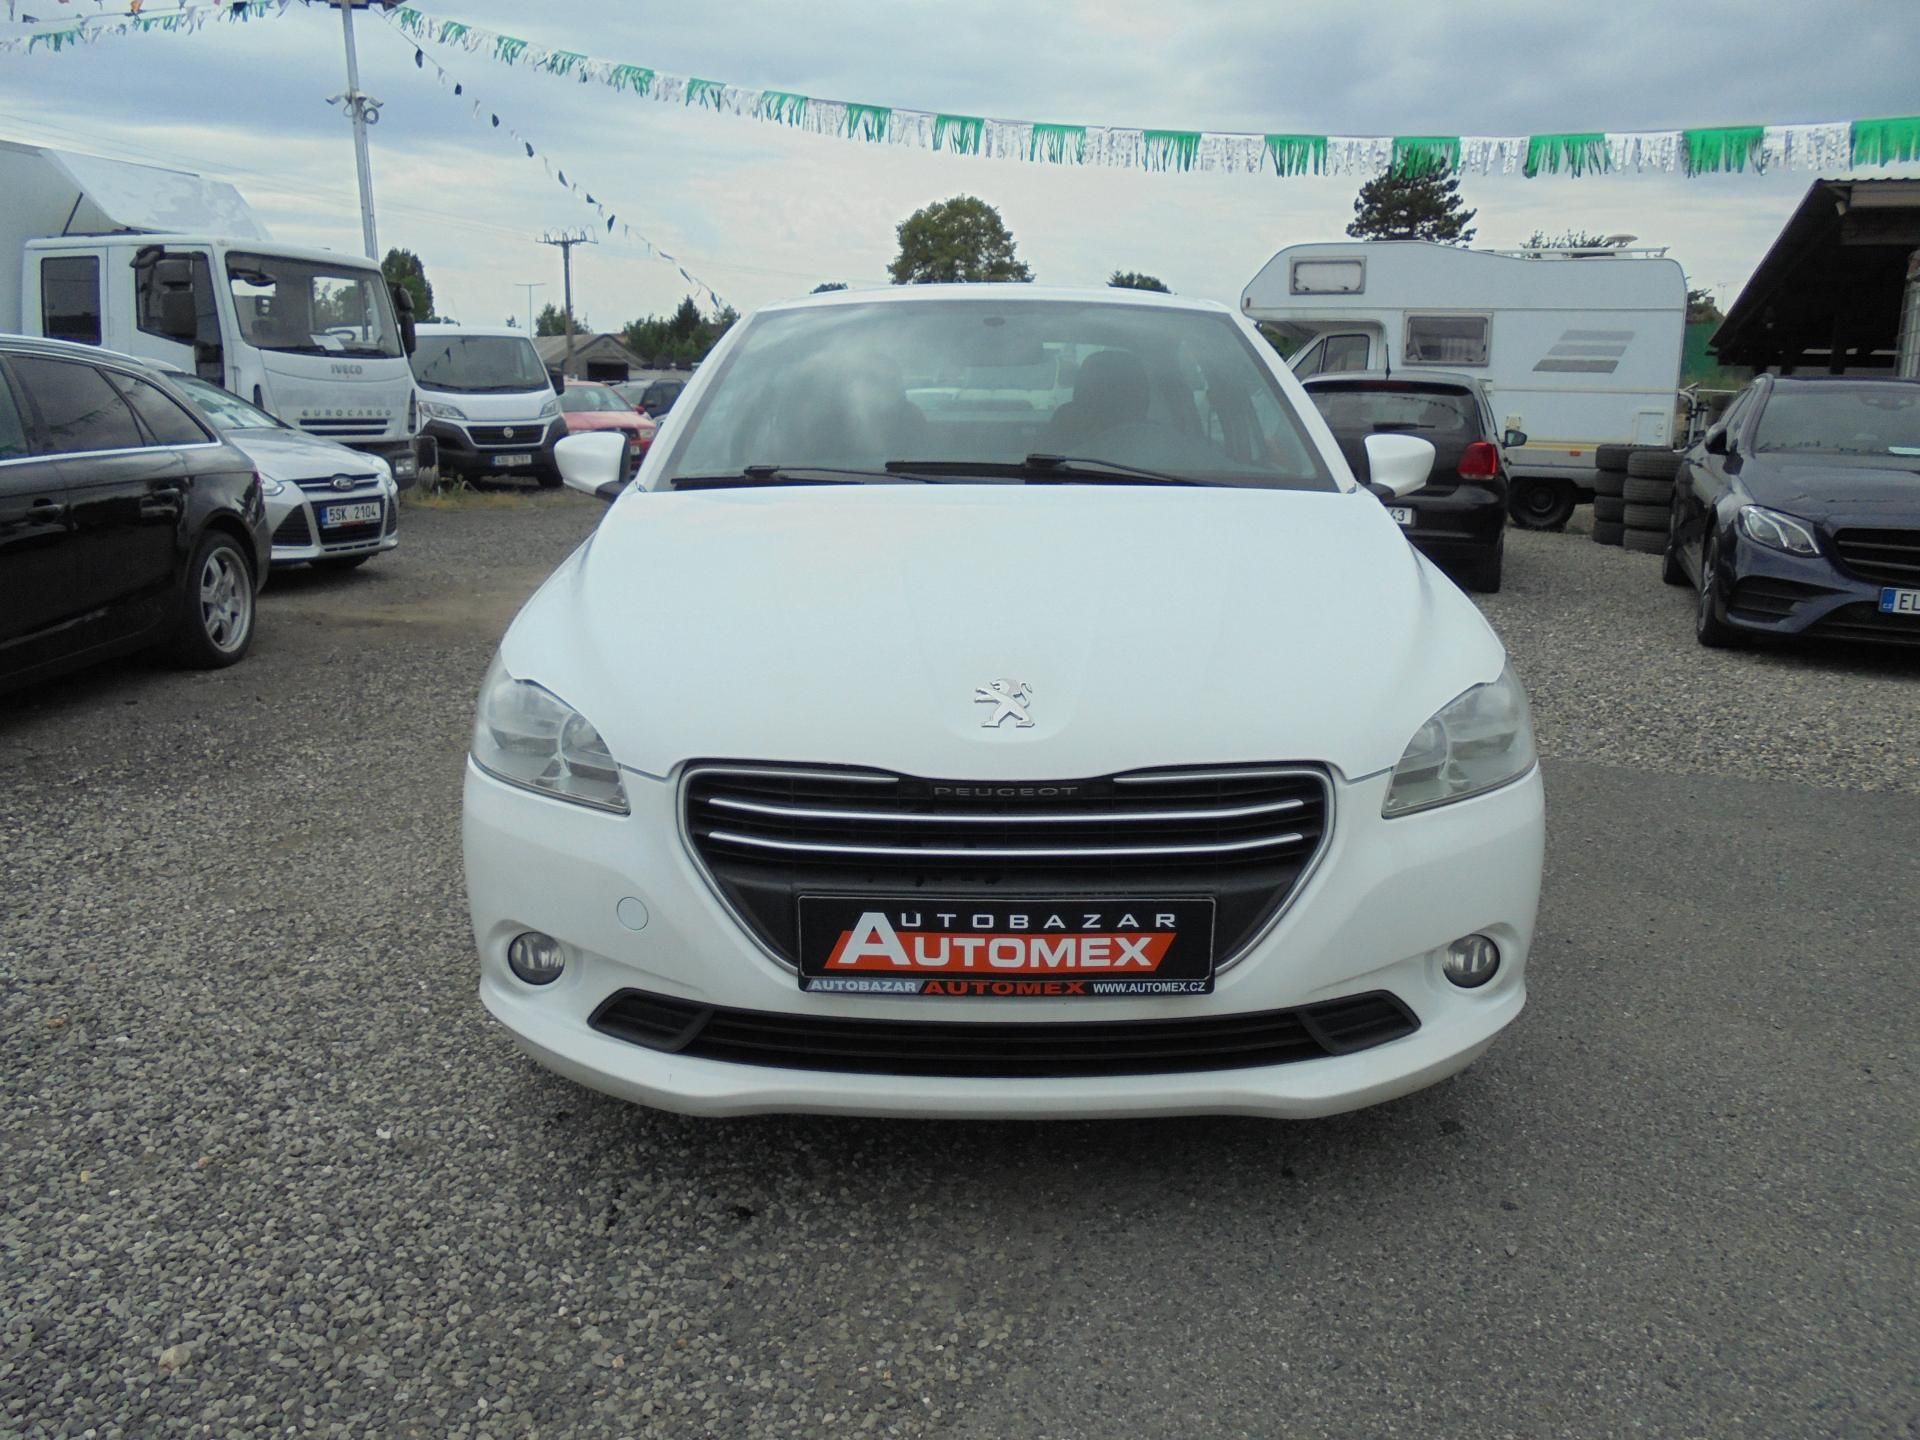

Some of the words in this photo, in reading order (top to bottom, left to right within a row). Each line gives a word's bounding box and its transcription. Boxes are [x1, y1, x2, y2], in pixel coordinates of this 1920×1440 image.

[330, 364, 363, 374] IVECO
[302, 409, 392, 417] EUROCARGO
[329, 508, 347, 521] 5SK
[354, 504, 376, 519] 2104
[934, 786, 1078, 796] PEUGEOT
[838, 911, 1152, 968] AUTOMEX
[810, 980, 916, 992] AUTOBAZAR
[924, 980, 1088, 996] AUTOMEX
[1093, 981, 1206, 994] WWW.AUTOMEX.CZ
